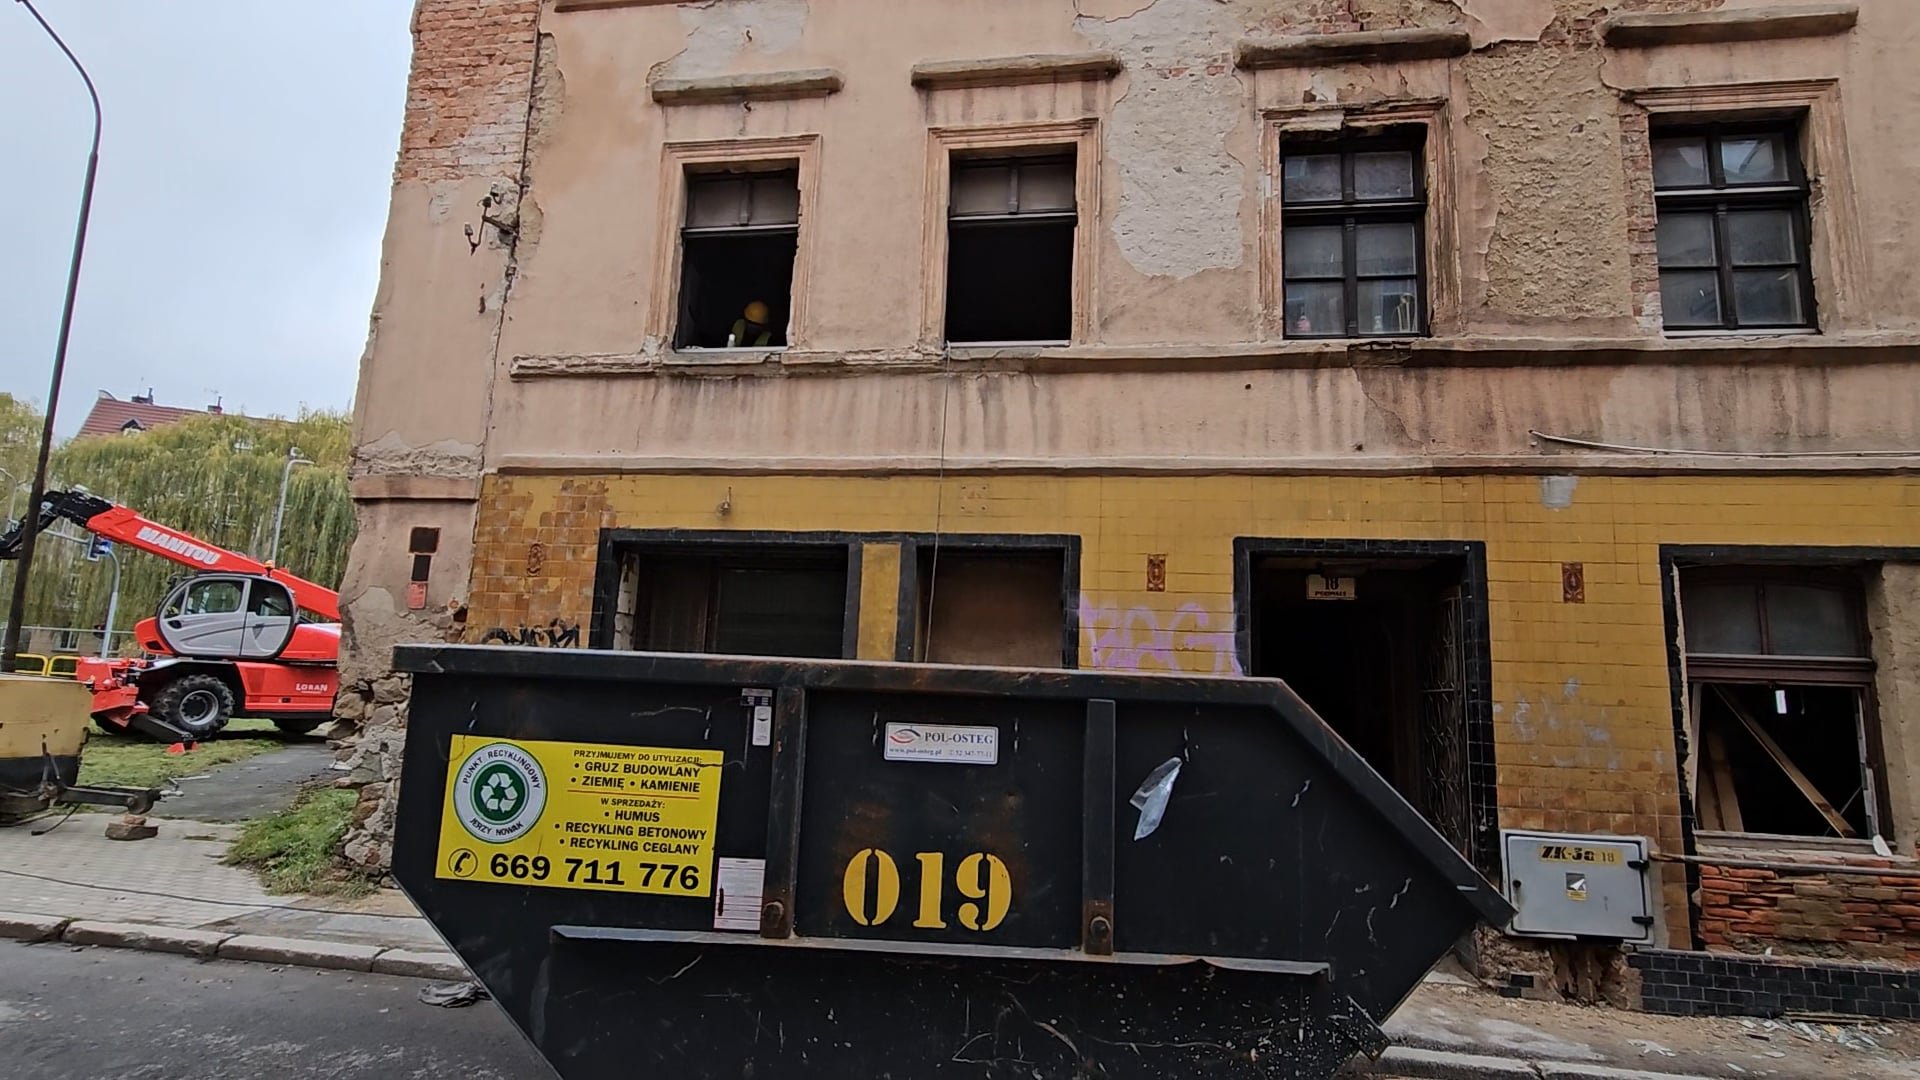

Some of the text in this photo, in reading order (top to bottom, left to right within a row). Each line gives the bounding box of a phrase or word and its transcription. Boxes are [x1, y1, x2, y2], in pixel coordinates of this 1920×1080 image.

[135, 526, 221, 565] MANITOU
[924, 731, 993, 744] POL-OSTEG
[573, 749, 702, 764] PRZYJMUJEMY DO UTYLIZACJI:
[463, 749, 541, 789] PUNKT RECYKLINGOWY
[585, 761, 700, 778] GRUZ BUDOWLANY
[581, 775, 700, 792] ZIEMIĘ KAMIENIE
[611, 798, 666, 809] SPRZEDAŻY:
[614, 810, 660, 822] HUMUS
[470, 817, 524, 836] JERZY NOWAK
[565, 822, 707, 840] RECYKLING BETONOWY
[570, 837, 700, 855] RECYKLING CEGLANY
[490, 853, 700, 890] 669 711 776
[843, 848, 1012, 932] 019
